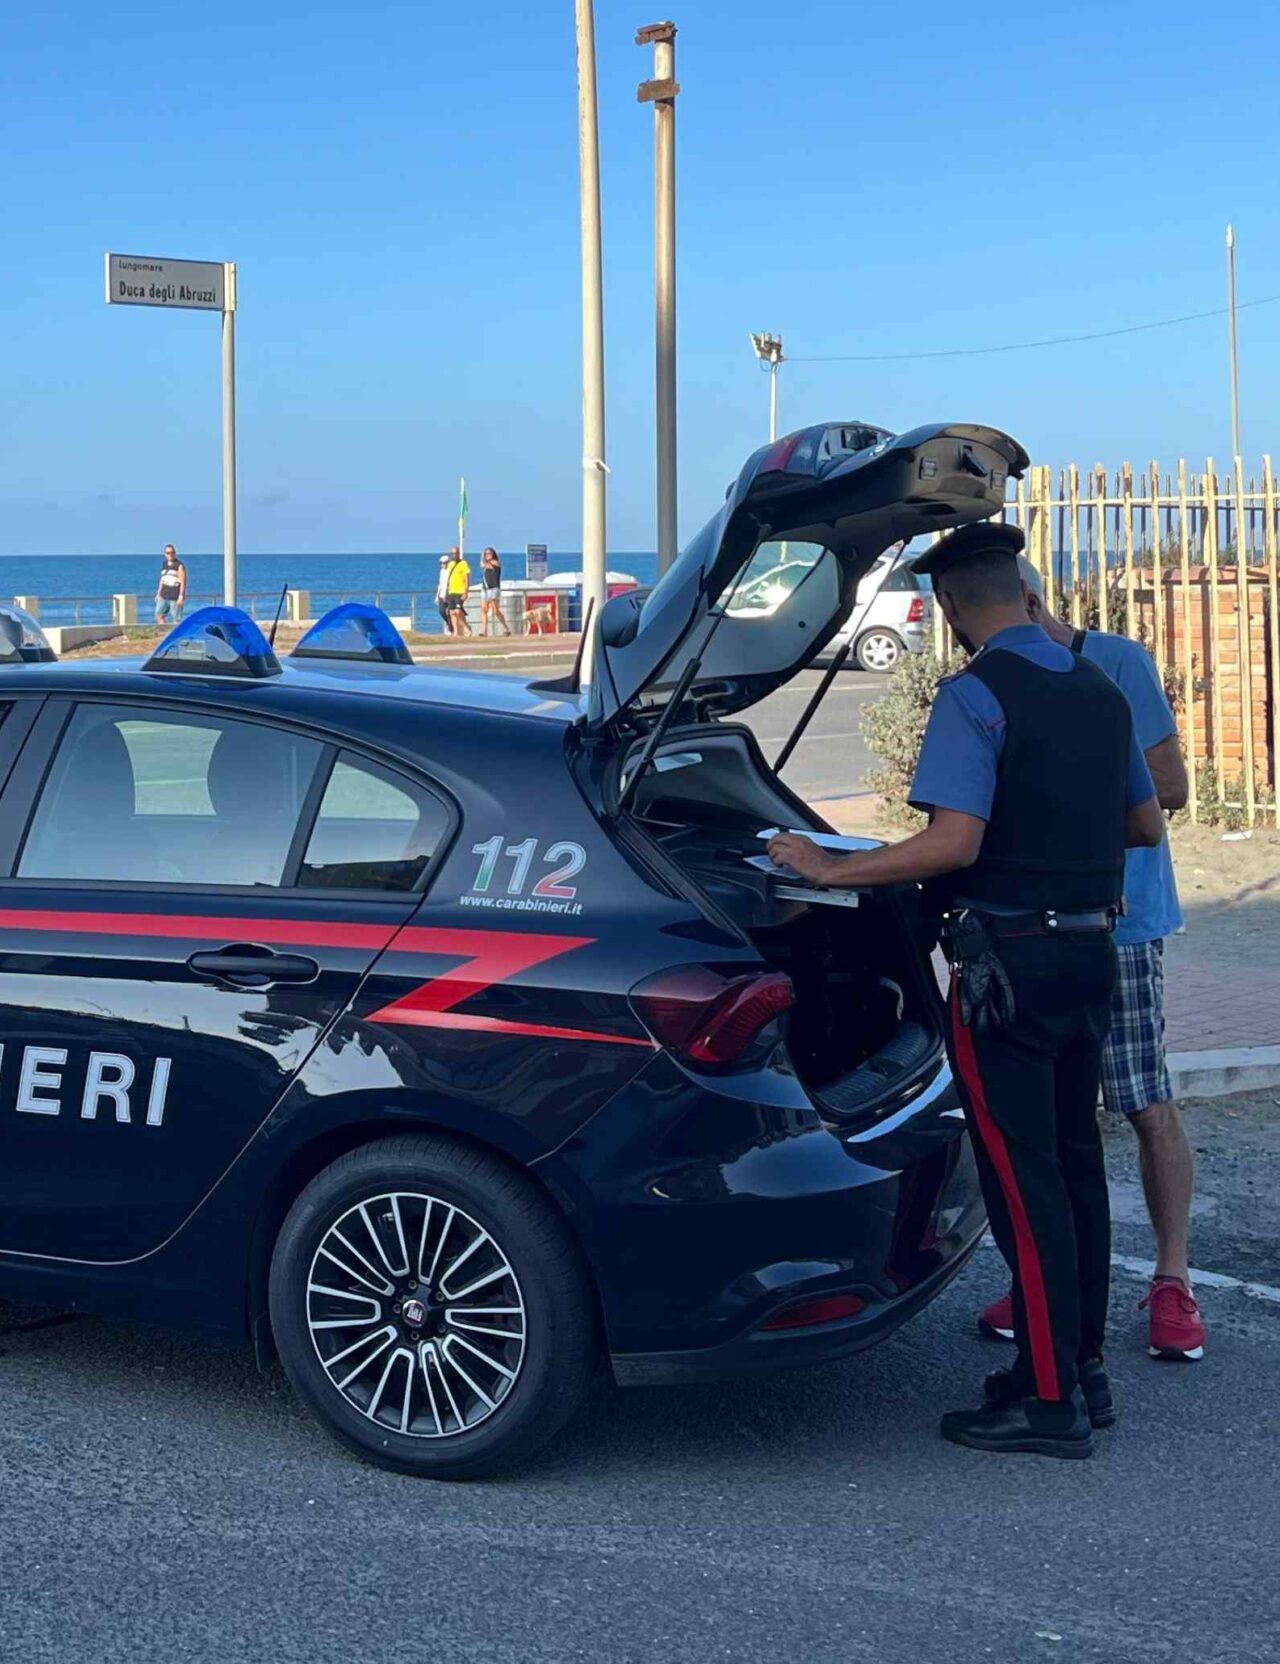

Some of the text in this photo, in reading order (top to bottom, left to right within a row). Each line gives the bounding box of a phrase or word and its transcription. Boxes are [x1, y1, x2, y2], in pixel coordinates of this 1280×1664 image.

[118, 260, 163, 272] lungomare
[119, 281, 216, 303] Duca degli Abruzzi
[472, 835, 587, 899] 112
[460, 895, 583, 915] www.carabinieri.it
